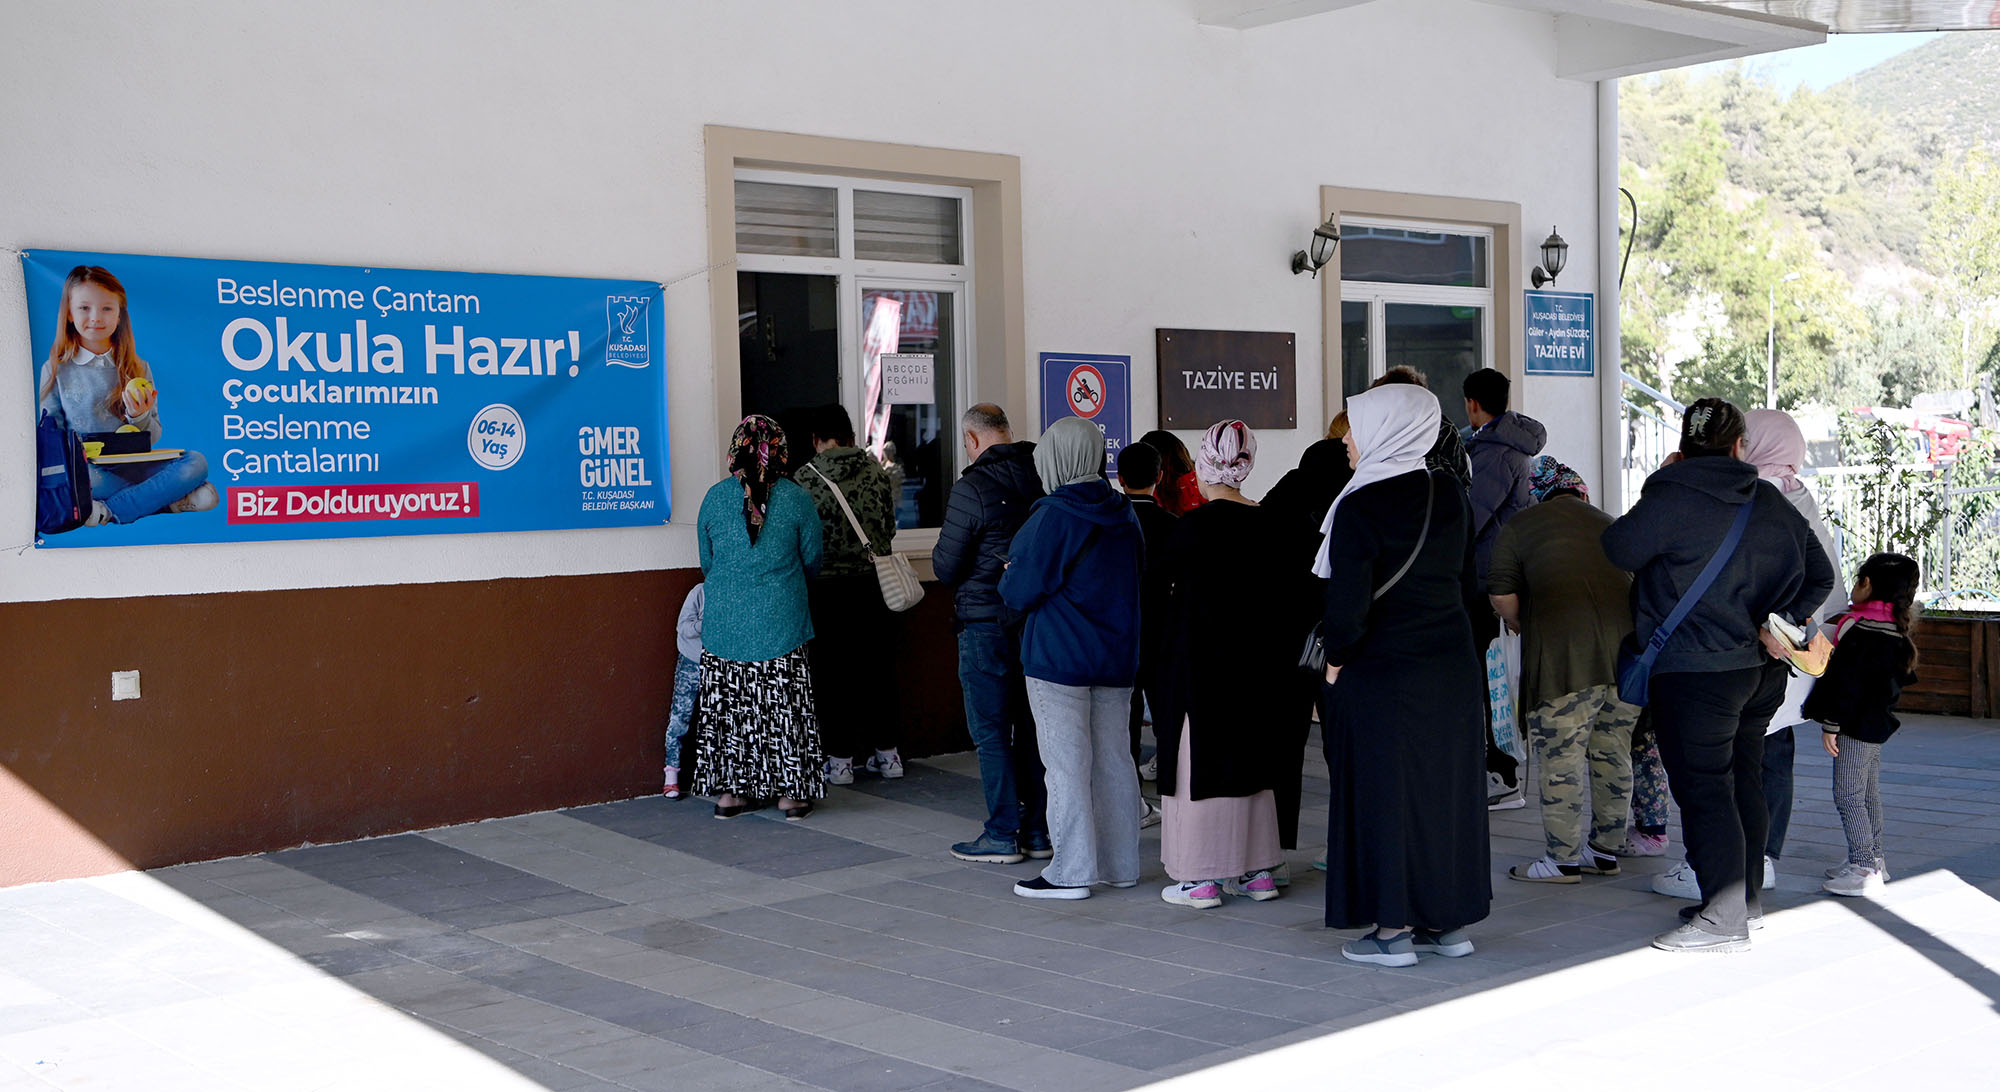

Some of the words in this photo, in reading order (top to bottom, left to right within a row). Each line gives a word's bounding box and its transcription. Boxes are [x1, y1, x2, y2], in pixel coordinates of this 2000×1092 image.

[217, 278, 365, 310] Beslenme
[372, 285, 480, 318] Çantam
[1533, 312, 1557, 322] KUŞADASI
[622, 335, 633, 343] T.C.
[1549, 328, 1566, 339] Aydın
[221, 316, 404, 374] Okula
[425, 324, 580, 378] Hazır!
[608, 344, 647, 352] KUŞADASI
[1534, 341, 1568, 359] TAZİYE
[1569, 342, 1585, 359] EVİ
[1182, 365, 1245, 390] TAZİYE
[1250, 366, 1277, 390] EVİ
[222, 379, 439, 409] Çocuklarımızın
[223, 413, 371, 440] Beslenme
[477, 419, 516, 438] 06-14
[482, 438, 508, 460] Yaş
[222, 447, 379, 481] Çantalarını
[580, 458, 652, 488] GÜNEL
[237, 489, 278, 517] Biz
[286, 484, 471, 519] Dolduruyoruz!
[582, 491, 596, 500] T.C.
[597, 490, 635, 501] KUŞADASI
[582, 500, 619, 511] BELEDİYE
[620, 500, 655, 511] BAŞKANI
